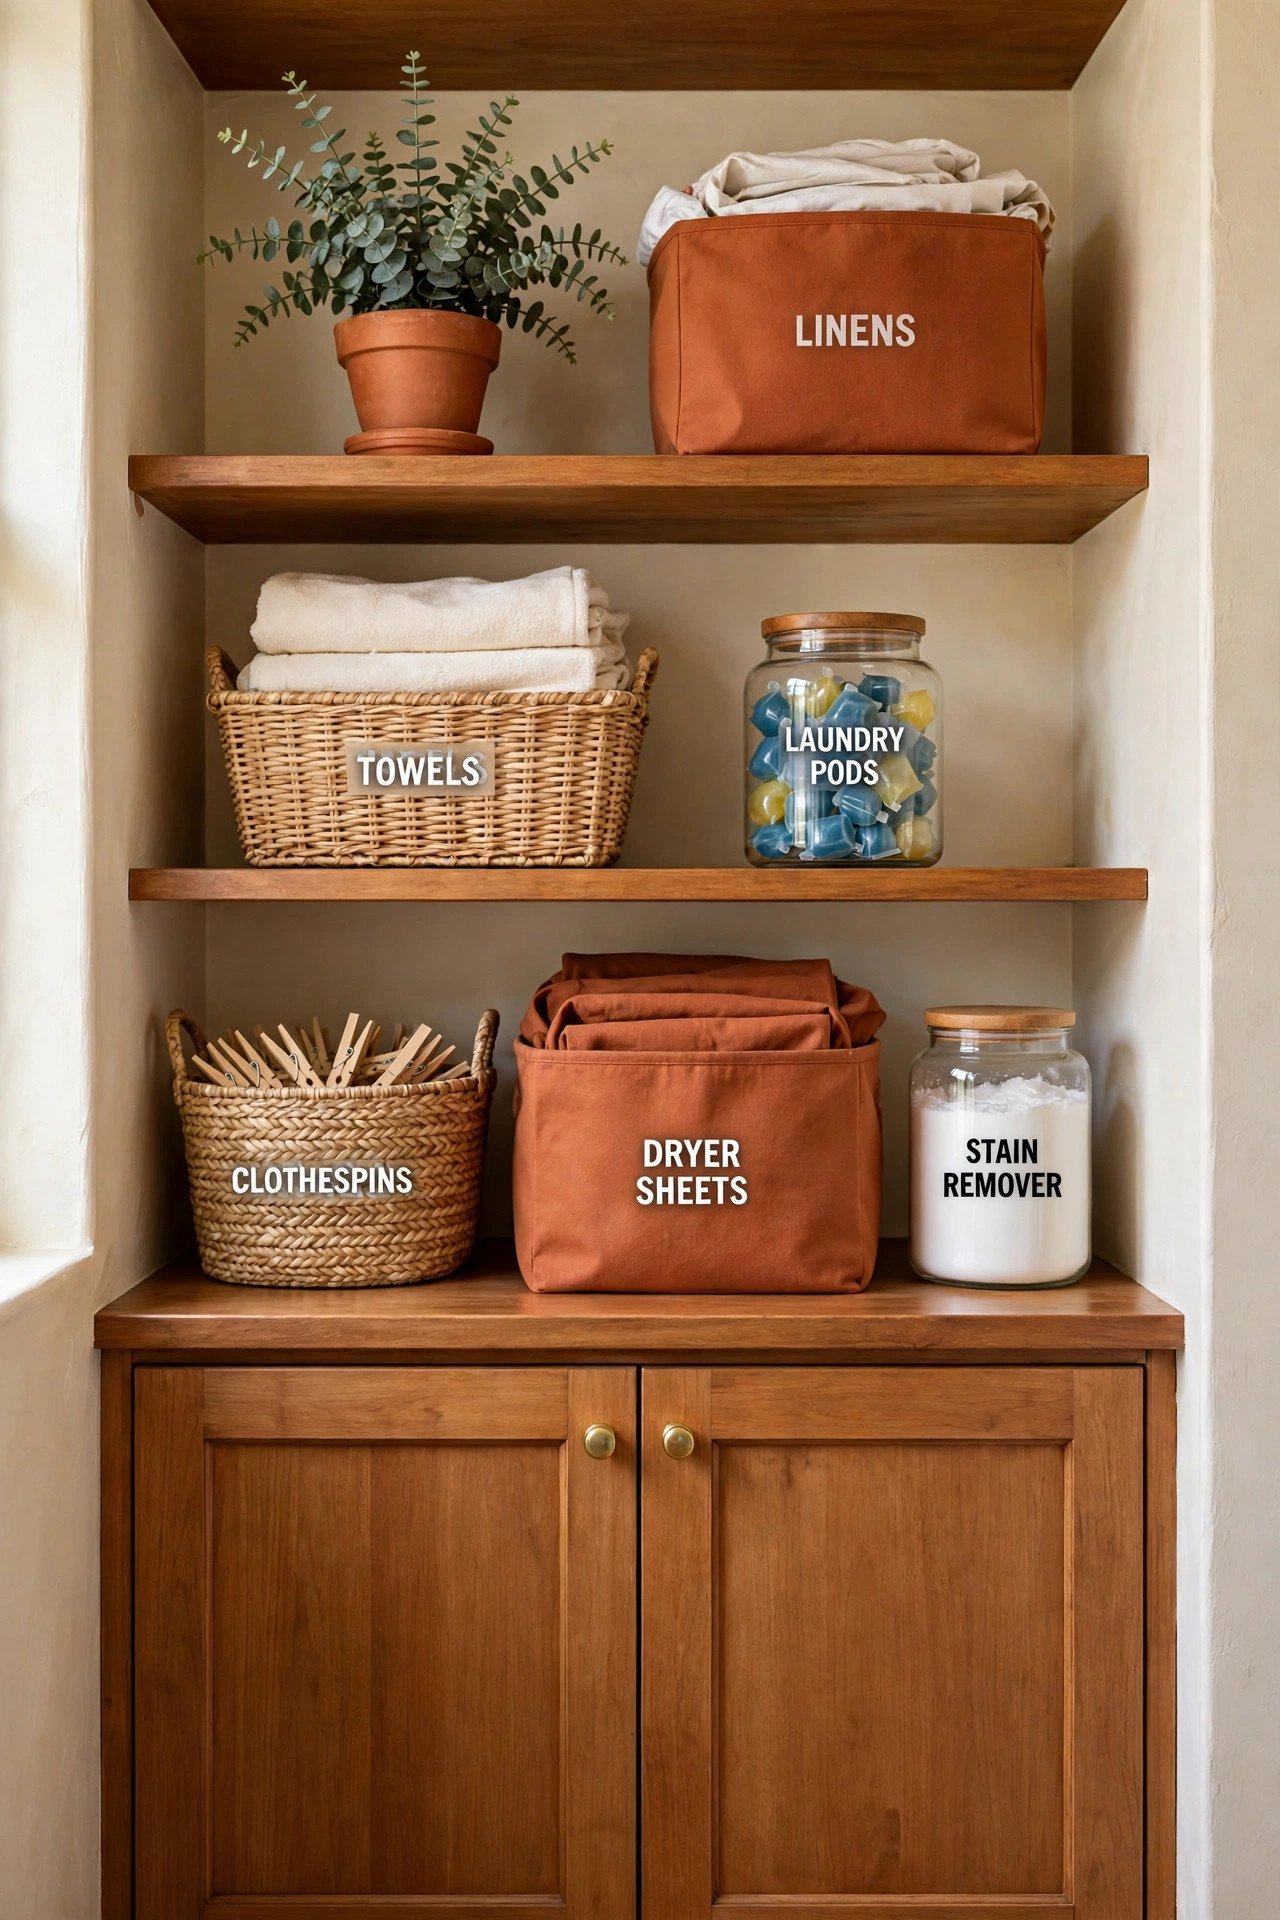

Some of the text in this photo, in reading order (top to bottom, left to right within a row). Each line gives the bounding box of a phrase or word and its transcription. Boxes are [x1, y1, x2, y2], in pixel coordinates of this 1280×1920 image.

[796, 313, 916, 347] LINENS
[785, 726, 905, 752] LAUNDRY
[356, 756, 480, 786] TOWELS
[811, 759, 879, 786] PODS
[643, 1139, 741, 1168] DRYER
[966, 1138, 1038, 1164] STAIN
[231, 1166, 413, 1194] CLOTHESPINS
[636, 1175, 748, 1205] SHEETS
[943, 1172, 1063, 1198] REMOVER
